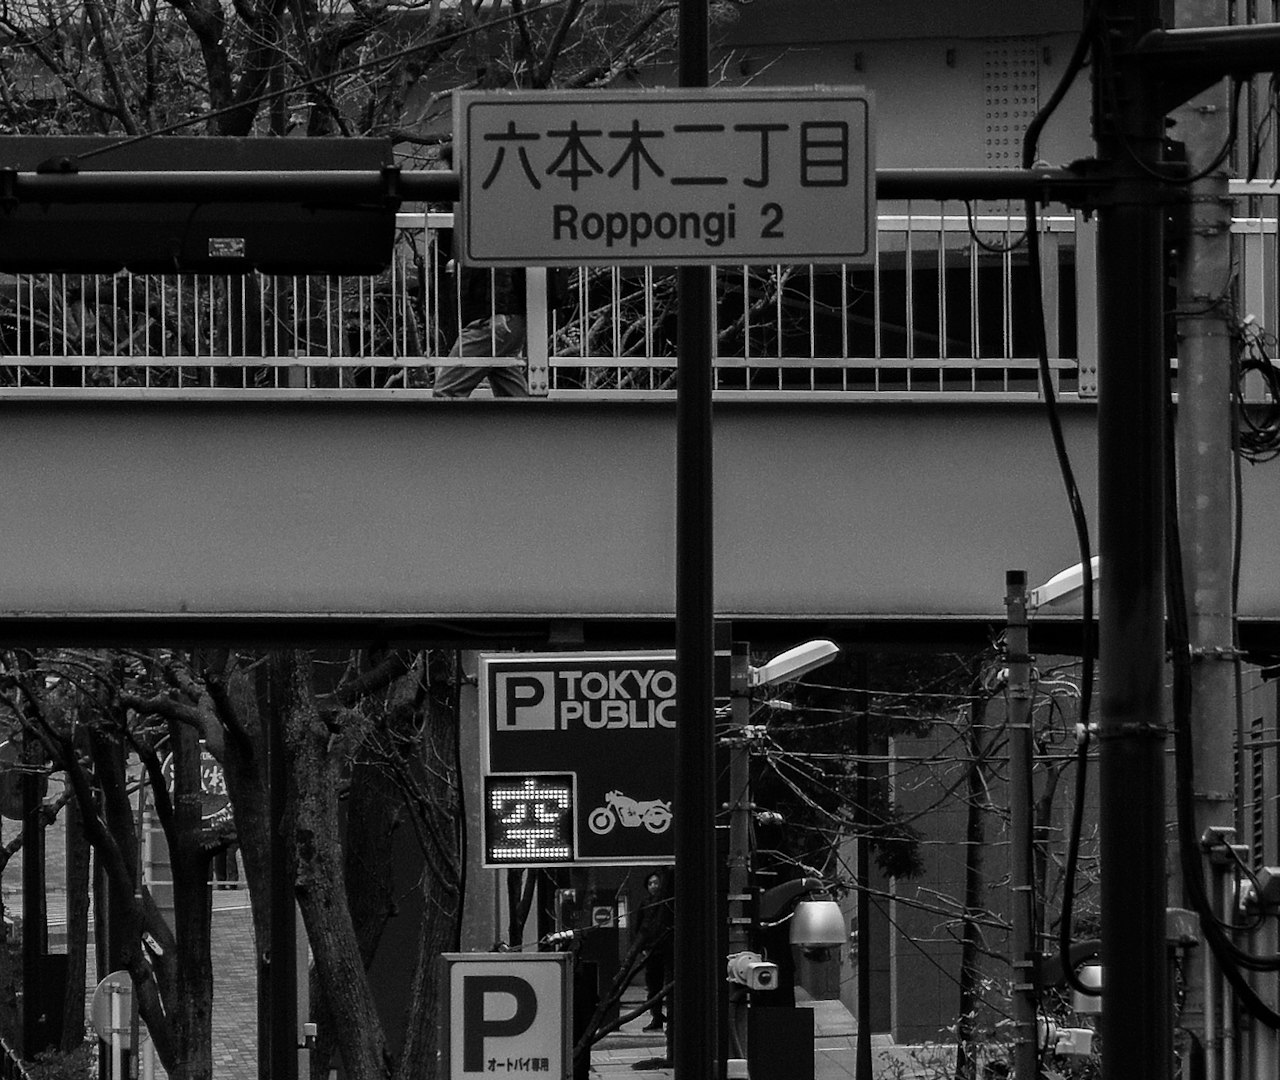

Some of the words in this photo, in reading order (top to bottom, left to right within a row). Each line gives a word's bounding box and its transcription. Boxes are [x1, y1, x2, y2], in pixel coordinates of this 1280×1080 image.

[482, 120, 848, 191] 六本木二丁目
[553, 203, 735, 247] Roppongi
[759, 203, 784, 239] 2
[559, 669, 677, 700] TOKYO
[560, 699, 677, 731] PUBLIC
[491, 780, 569, 859] 空
[463, 975, 538, 1073] P
[487, 1058, 549, 1072] オートバイ専用
